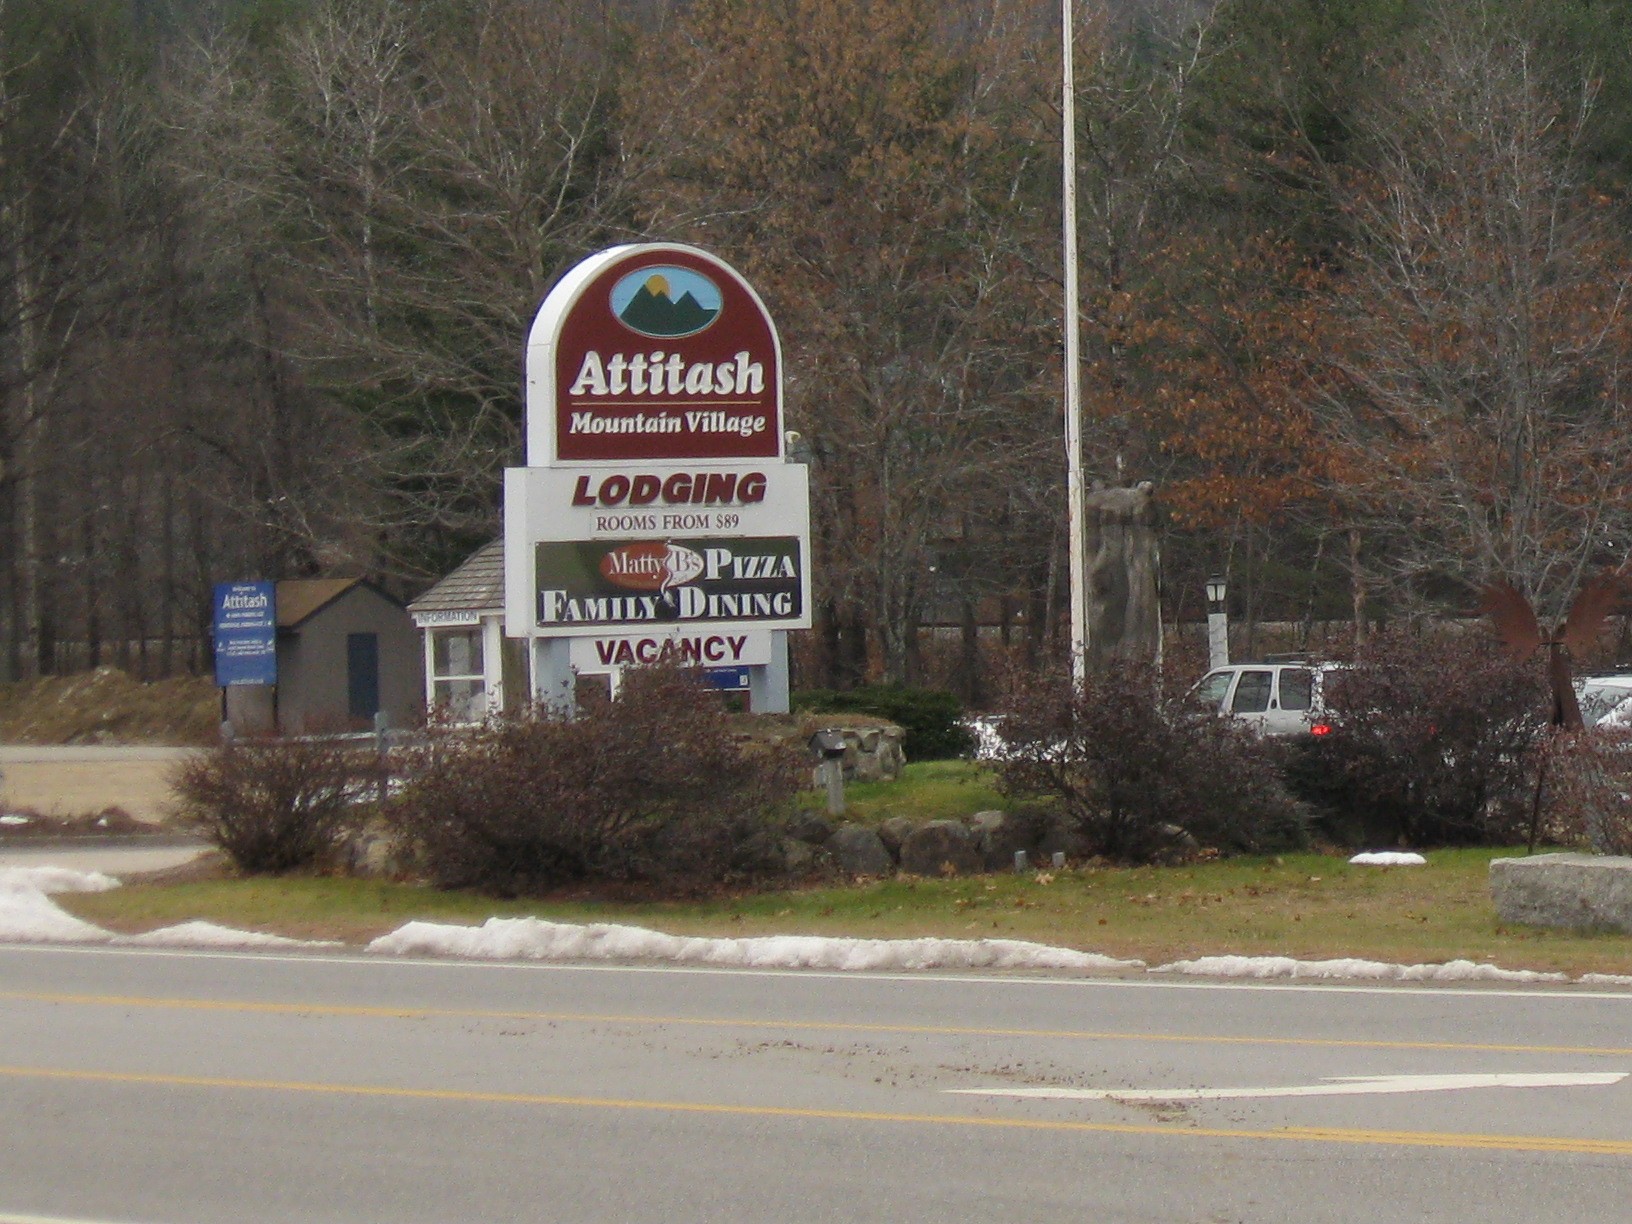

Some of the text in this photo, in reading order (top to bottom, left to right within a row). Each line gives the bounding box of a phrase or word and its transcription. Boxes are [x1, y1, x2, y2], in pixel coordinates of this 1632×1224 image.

[569, 351, 764, 395] Attitash
[569, 411, 765, 437] Mountain Village
[572, 472, 767, 506] LODGING
[596, 513, 739, 531] ROOMS FROM $89
[608, 552, 663, 579] Matty
[672, 552, 700, 572] B's
[704, 548, 796, 580] PIZZA
[223, 592, 268, 609] Attitash
[541, 587, 793, 622] FAMILY DINING
[418, 610, 477, 623] INFORMATION
[595, 636, 747, 665] VACANCY
